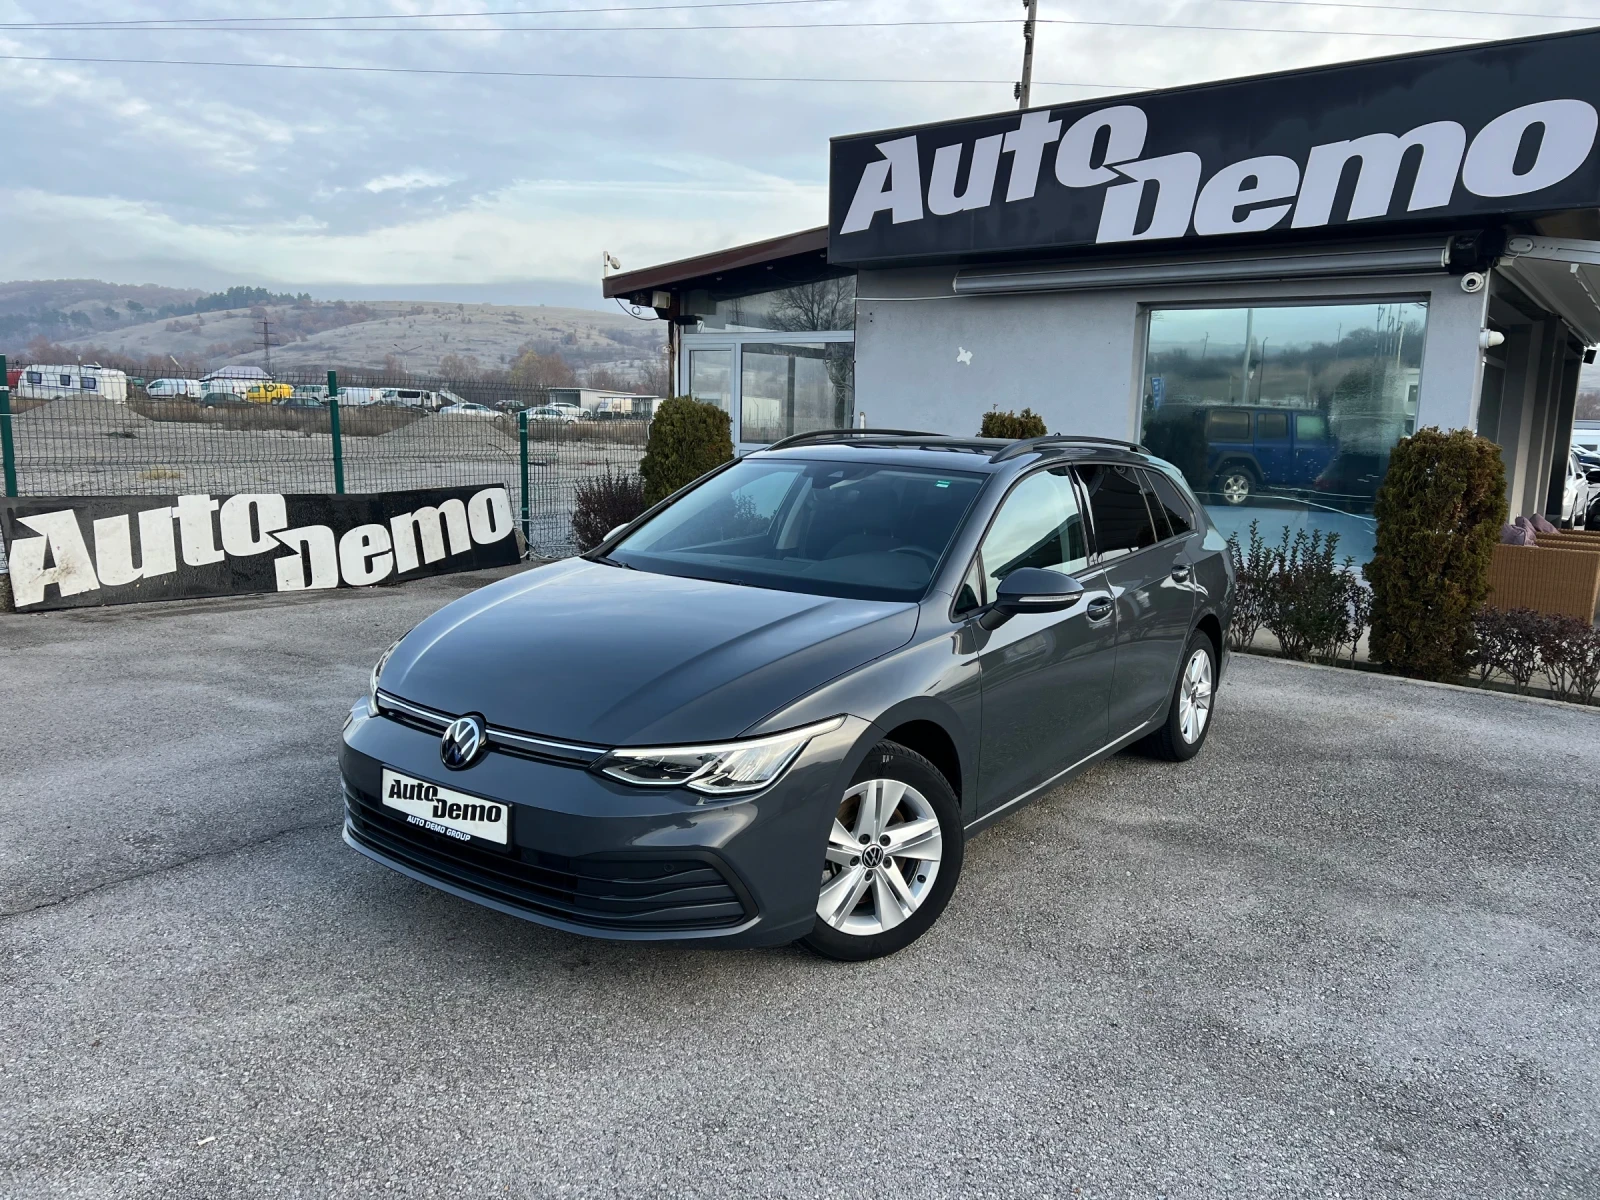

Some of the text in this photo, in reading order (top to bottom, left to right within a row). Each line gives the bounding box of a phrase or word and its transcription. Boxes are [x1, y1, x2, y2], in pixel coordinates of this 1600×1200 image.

[839, 98, 1599, 244] Auto Demo
[8, 487, 515, 608] Auto Demo
[388, 779, 502, 823] Auto Demo
[406, 815, 471, 842] AUTO DEMO GROUP
